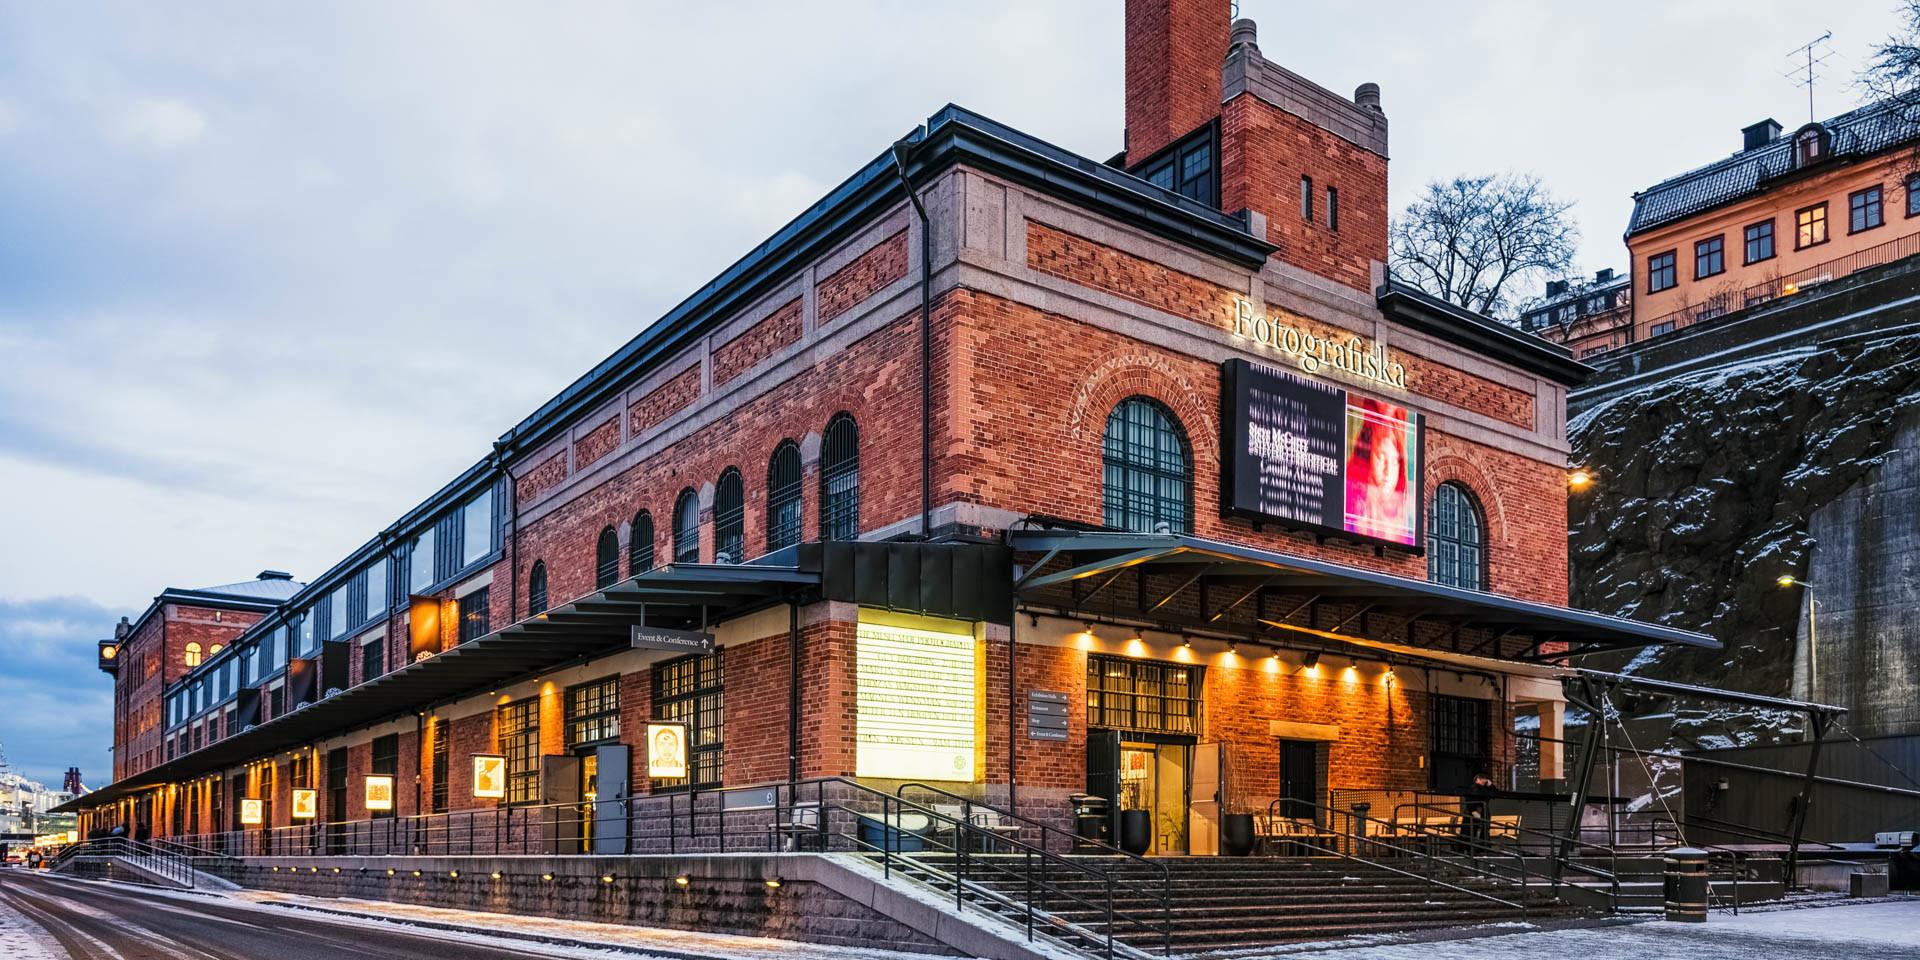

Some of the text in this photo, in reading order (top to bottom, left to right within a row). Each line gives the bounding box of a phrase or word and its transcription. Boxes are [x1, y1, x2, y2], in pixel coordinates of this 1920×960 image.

[1233, 297, 1408, 389] Fotografiska
[637, 632, 699, 646] Event & Conference
